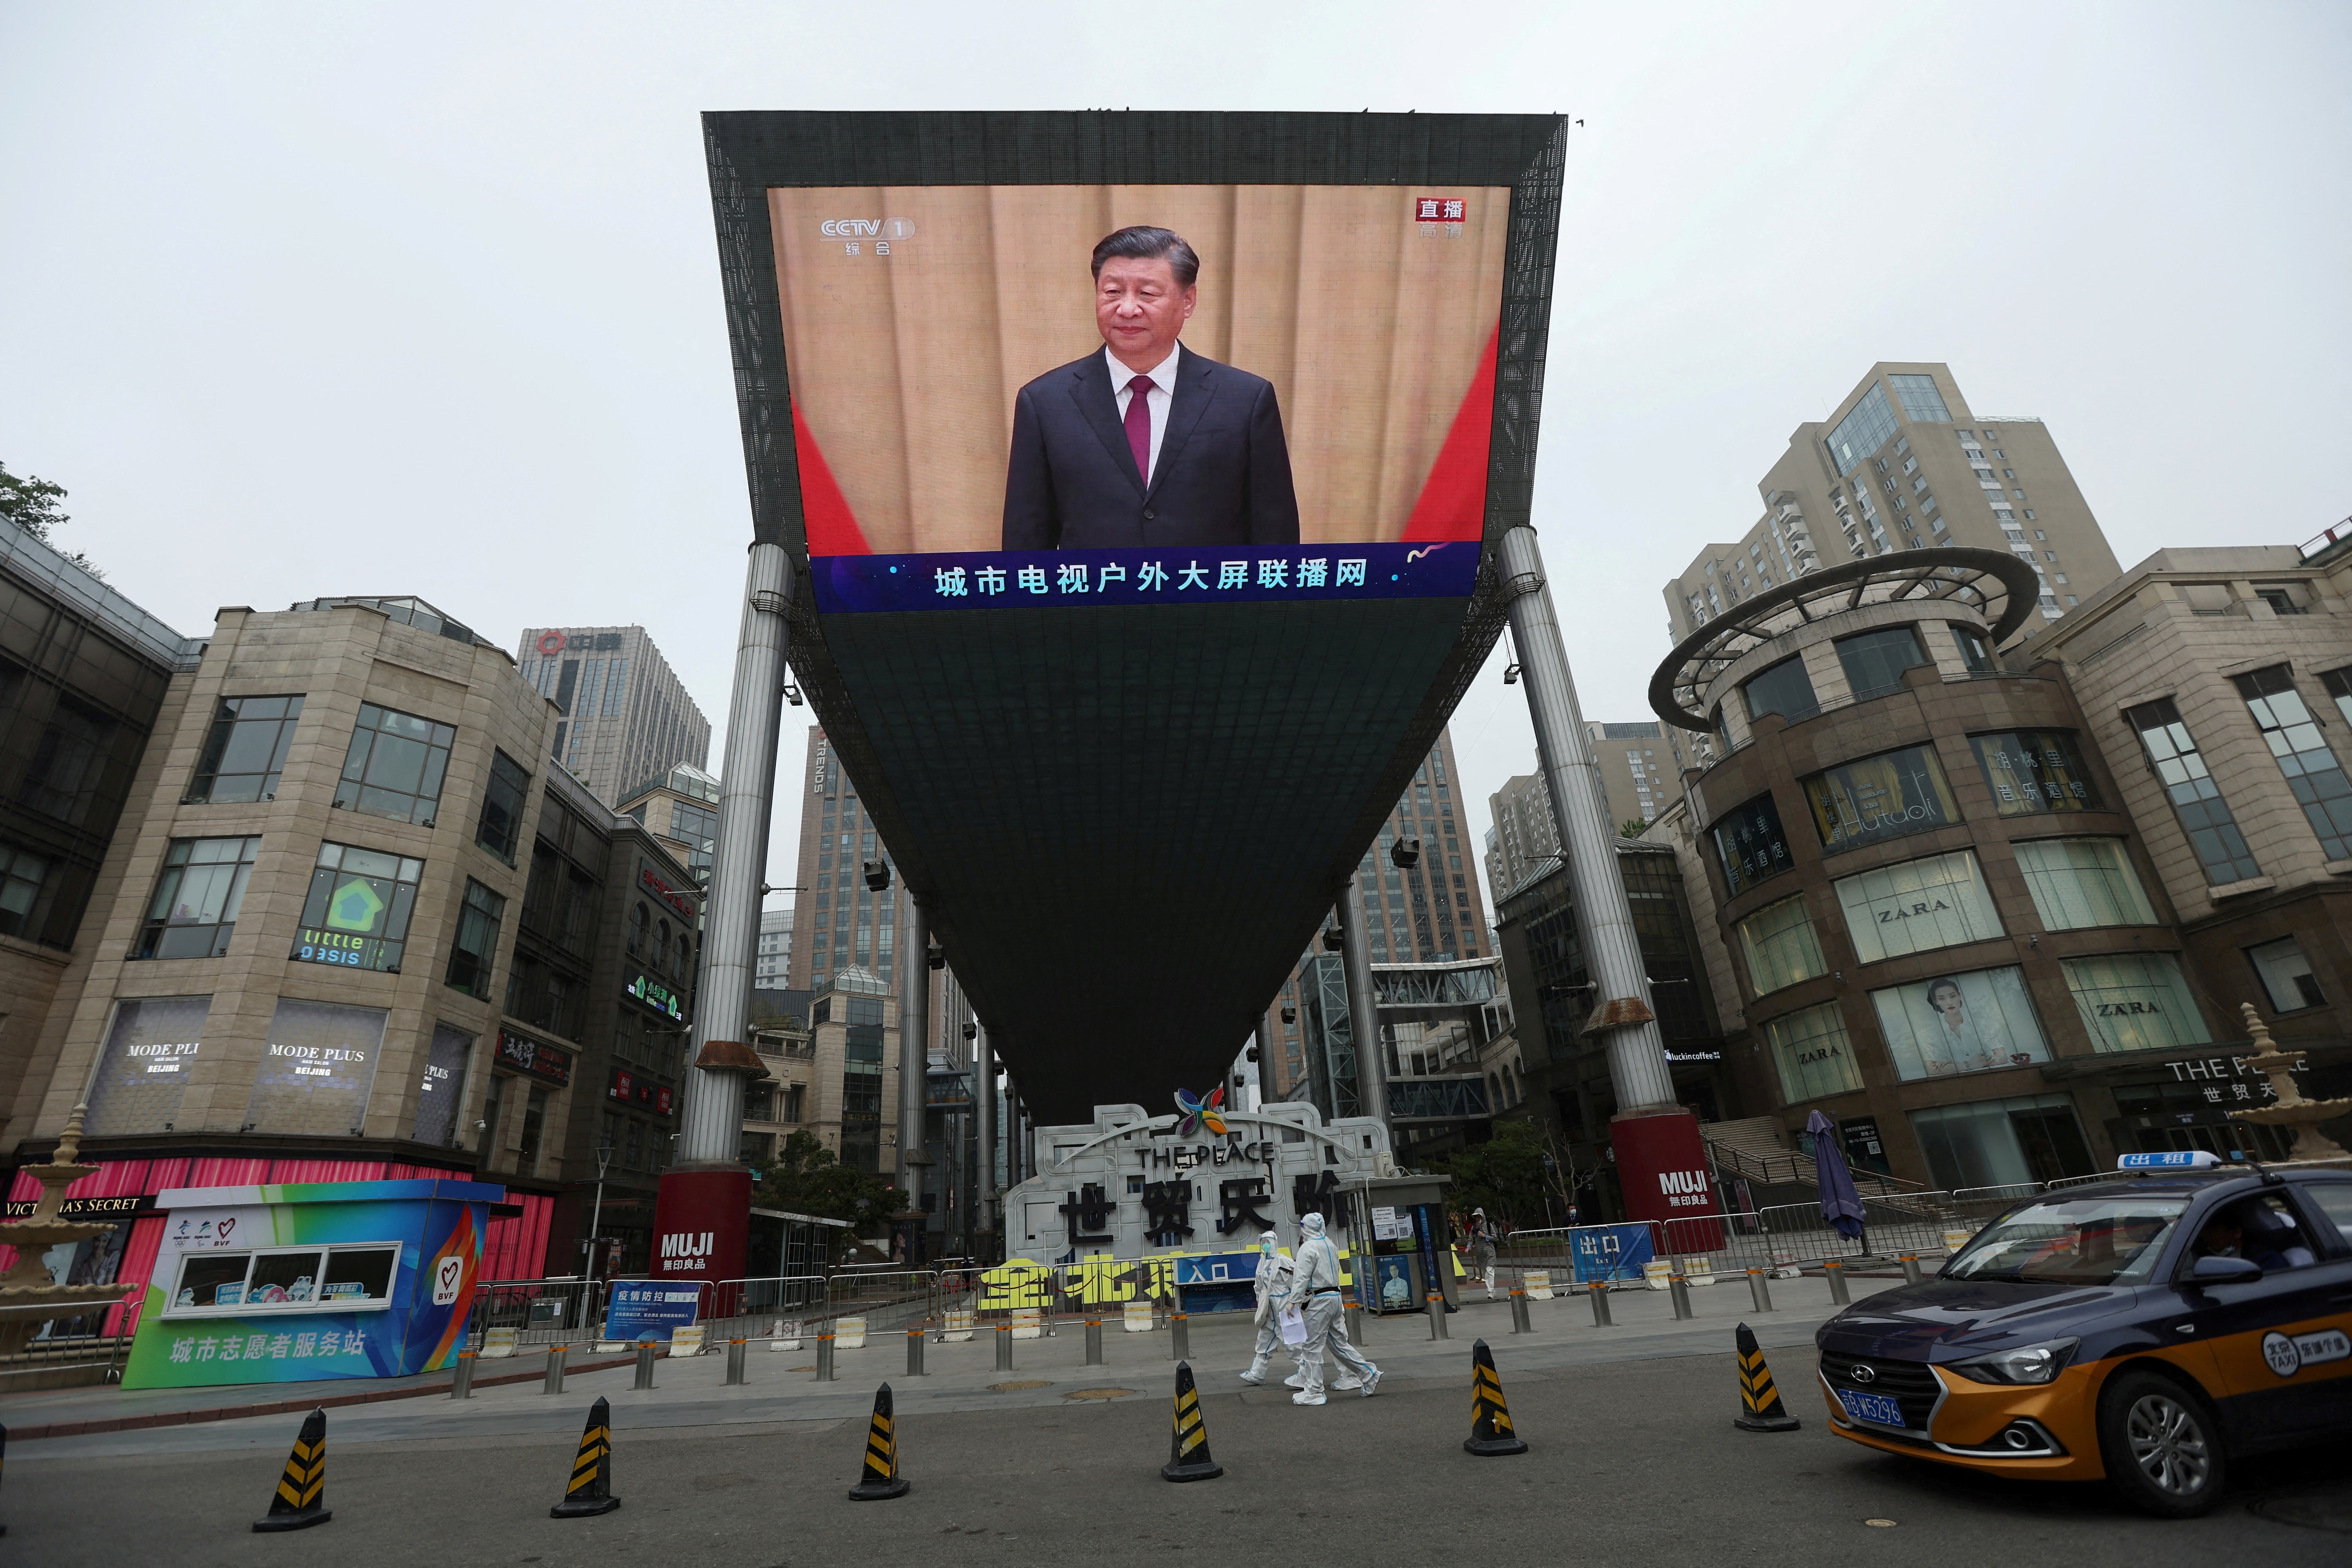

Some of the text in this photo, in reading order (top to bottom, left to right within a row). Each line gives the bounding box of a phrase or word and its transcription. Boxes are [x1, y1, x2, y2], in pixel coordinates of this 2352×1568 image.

[1420, 199, 1463, 218] 直播
[821, 219, 902, 237] CCTV 1
[1419, 221, 1463, 239] 高清
[845, 242, 890, 255] 综合
[934, 558, 1367, 597] 城市电视户外大屏联播网
[814, 739, 826, 793] TRENDS
[1998, 781, 2087, 801] 音乐酒馆
[1730, 842, 1784, 883] 音乐酒馆
[1878, 899, 1950, 923] ZARA
[304, 929, 363, 949] little
[301, 946, 360, 965] oasis
[2097, 1002, 2161, 1016] ZARA
[126, 1044, 172, 1057] MODE
[269, 1044, 365, 1062] MODE PLUS
[1799, 1045, 1842, 1064] ZARA
[147, 1065, 180, 1073] BEIJING
[295, 1067, 332, 1076] BEIJING
[429, 1065, 449, 1079] PLUS
[2165, 1059, 2229, 1082] THE
[2203, 1082, 2300, 1102] 世贸天
[1135, 1142, 1275, 1169] THE PLACE
[2130, 1154, 2185, 1165] 出租
[1659, 1170, 1708, 1195] MUJI
[7, 1199, 140, 1216] VICTIA'S SECRET
[1058, 1170, 1349, 1245] 世贸天阶
[1669, 1194, 1708, 1207] 無印良品
[660, 1232, 714, 1258] MUJI
[1580, 1235, 1620, 1255] 出口
[663, 1258, 706, 1271] 無印良品
[1189, 1263, 1229, 1282] 入口
[618, 1290, 664, 1302] 疫情防控
[169, 1329, 366, 1363] 城市志愿者服务站
[2267, 1341, 2291, 1356] 北京
[2270, 1353, 2296, 1369] TAXI
